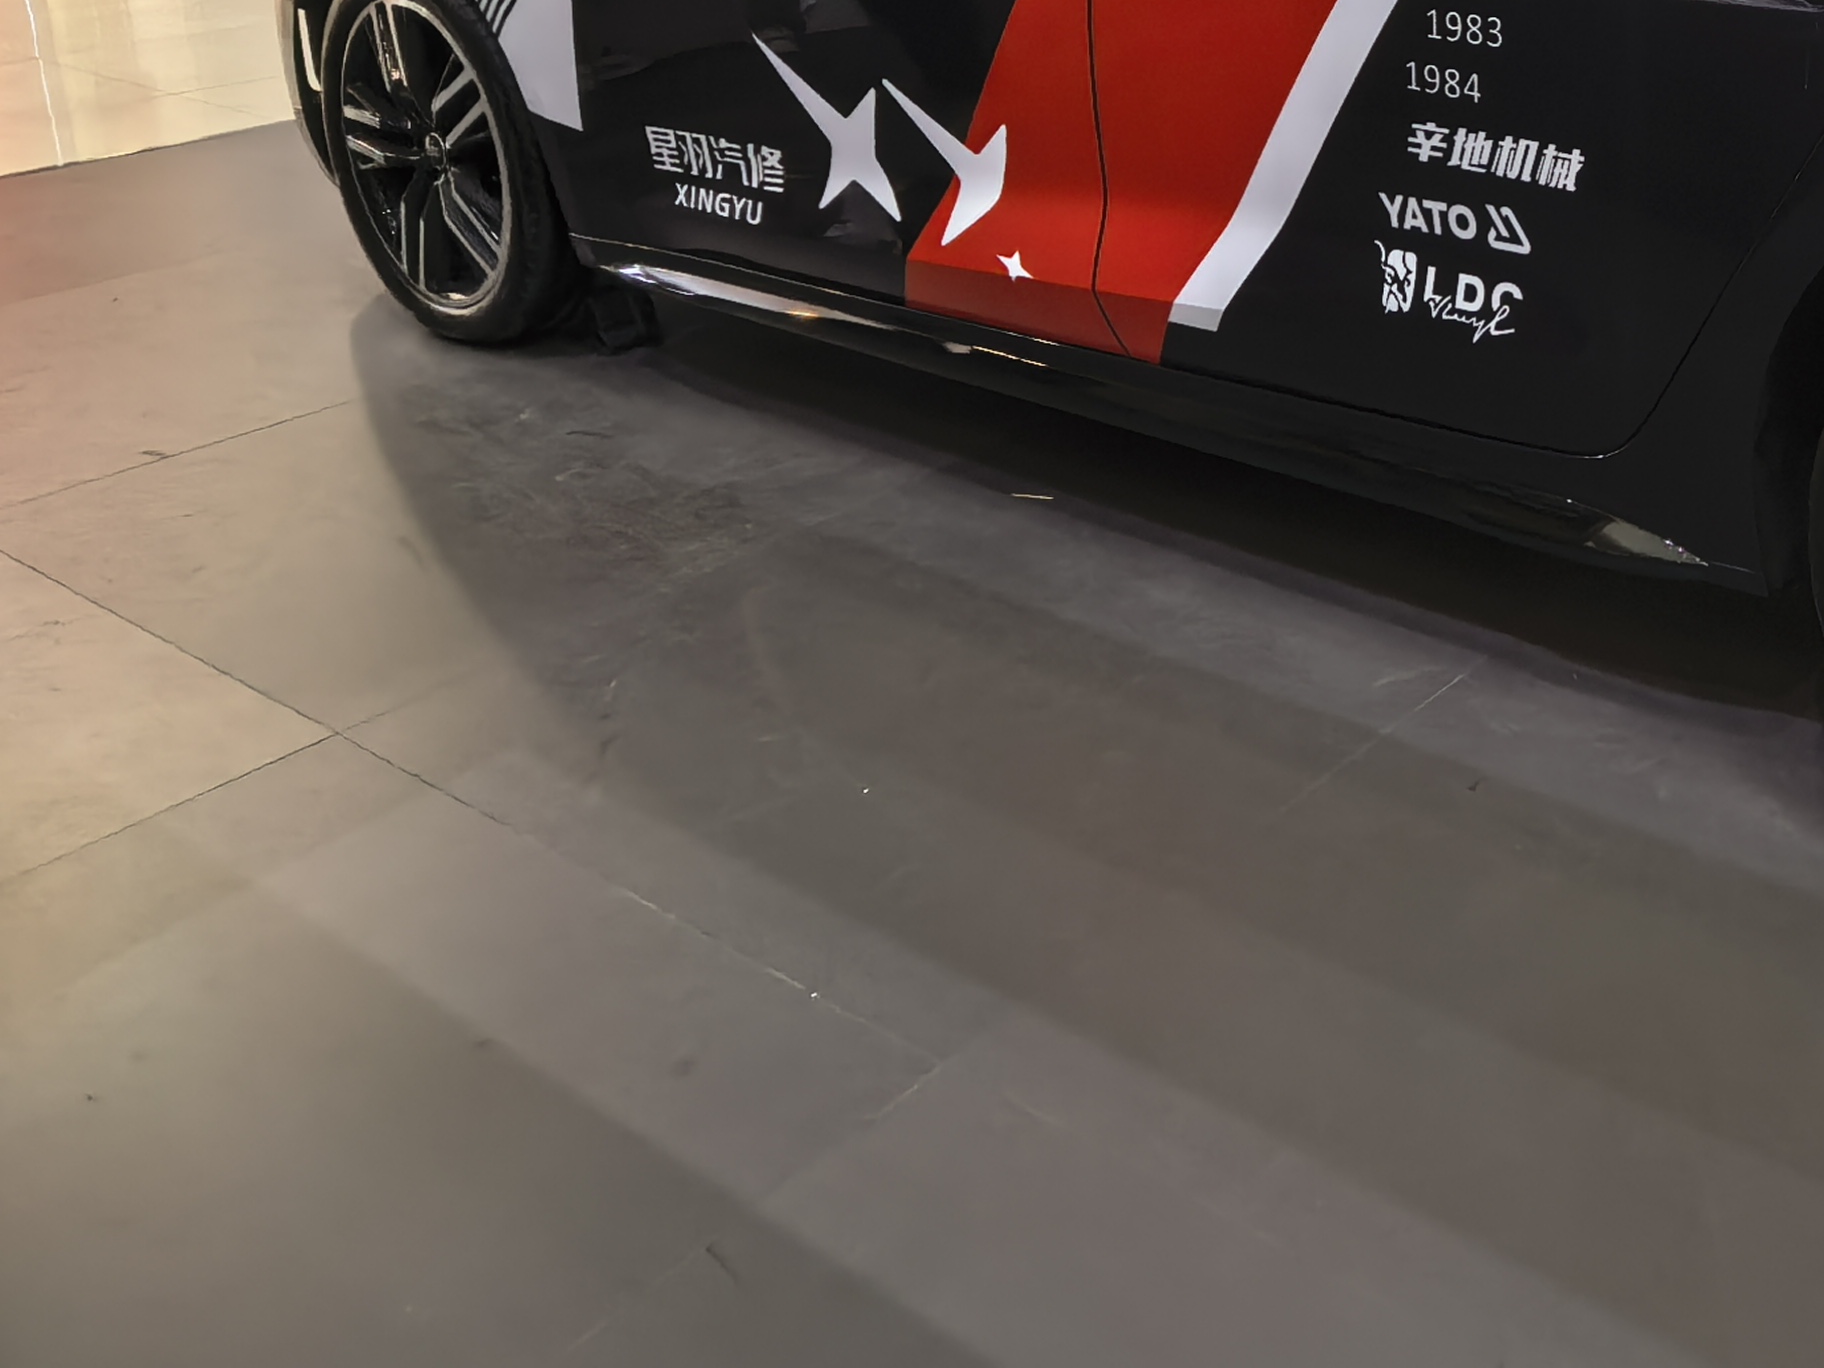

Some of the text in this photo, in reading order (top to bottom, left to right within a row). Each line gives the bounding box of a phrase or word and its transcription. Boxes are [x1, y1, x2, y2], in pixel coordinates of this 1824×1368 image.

[1426, 8, 1504, 48] 1983
[1405, 61, 1482, 104] 1984
[1406, 121, 1586, 193] 辛地机械
[674, 182, 764, 226] XINGYU
[1378, 192, 1477, 240] YATO
